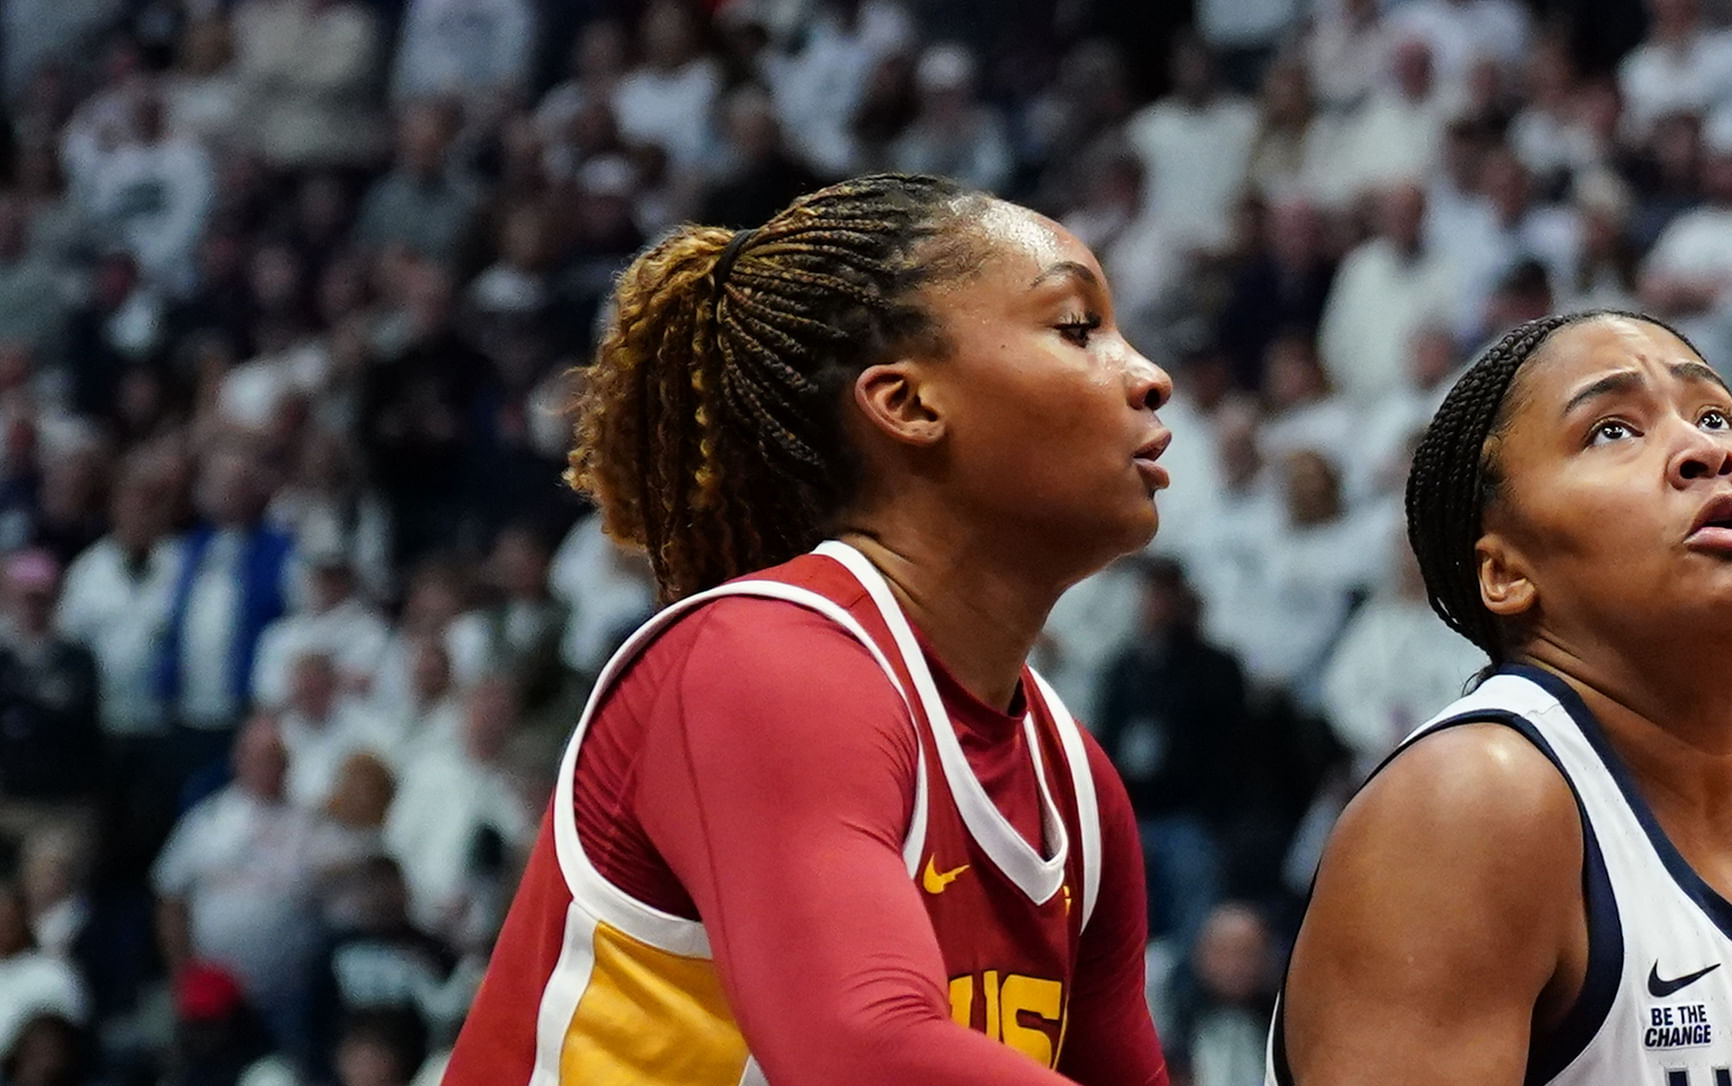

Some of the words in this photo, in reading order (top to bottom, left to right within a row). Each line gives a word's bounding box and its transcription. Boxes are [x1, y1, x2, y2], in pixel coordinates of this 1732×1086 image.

[1651, 1007, 1674, 1026] BE
[1677, 1004, 1707, 1024] THE
[1645, 1024, 1712, 1047] CHANGE
